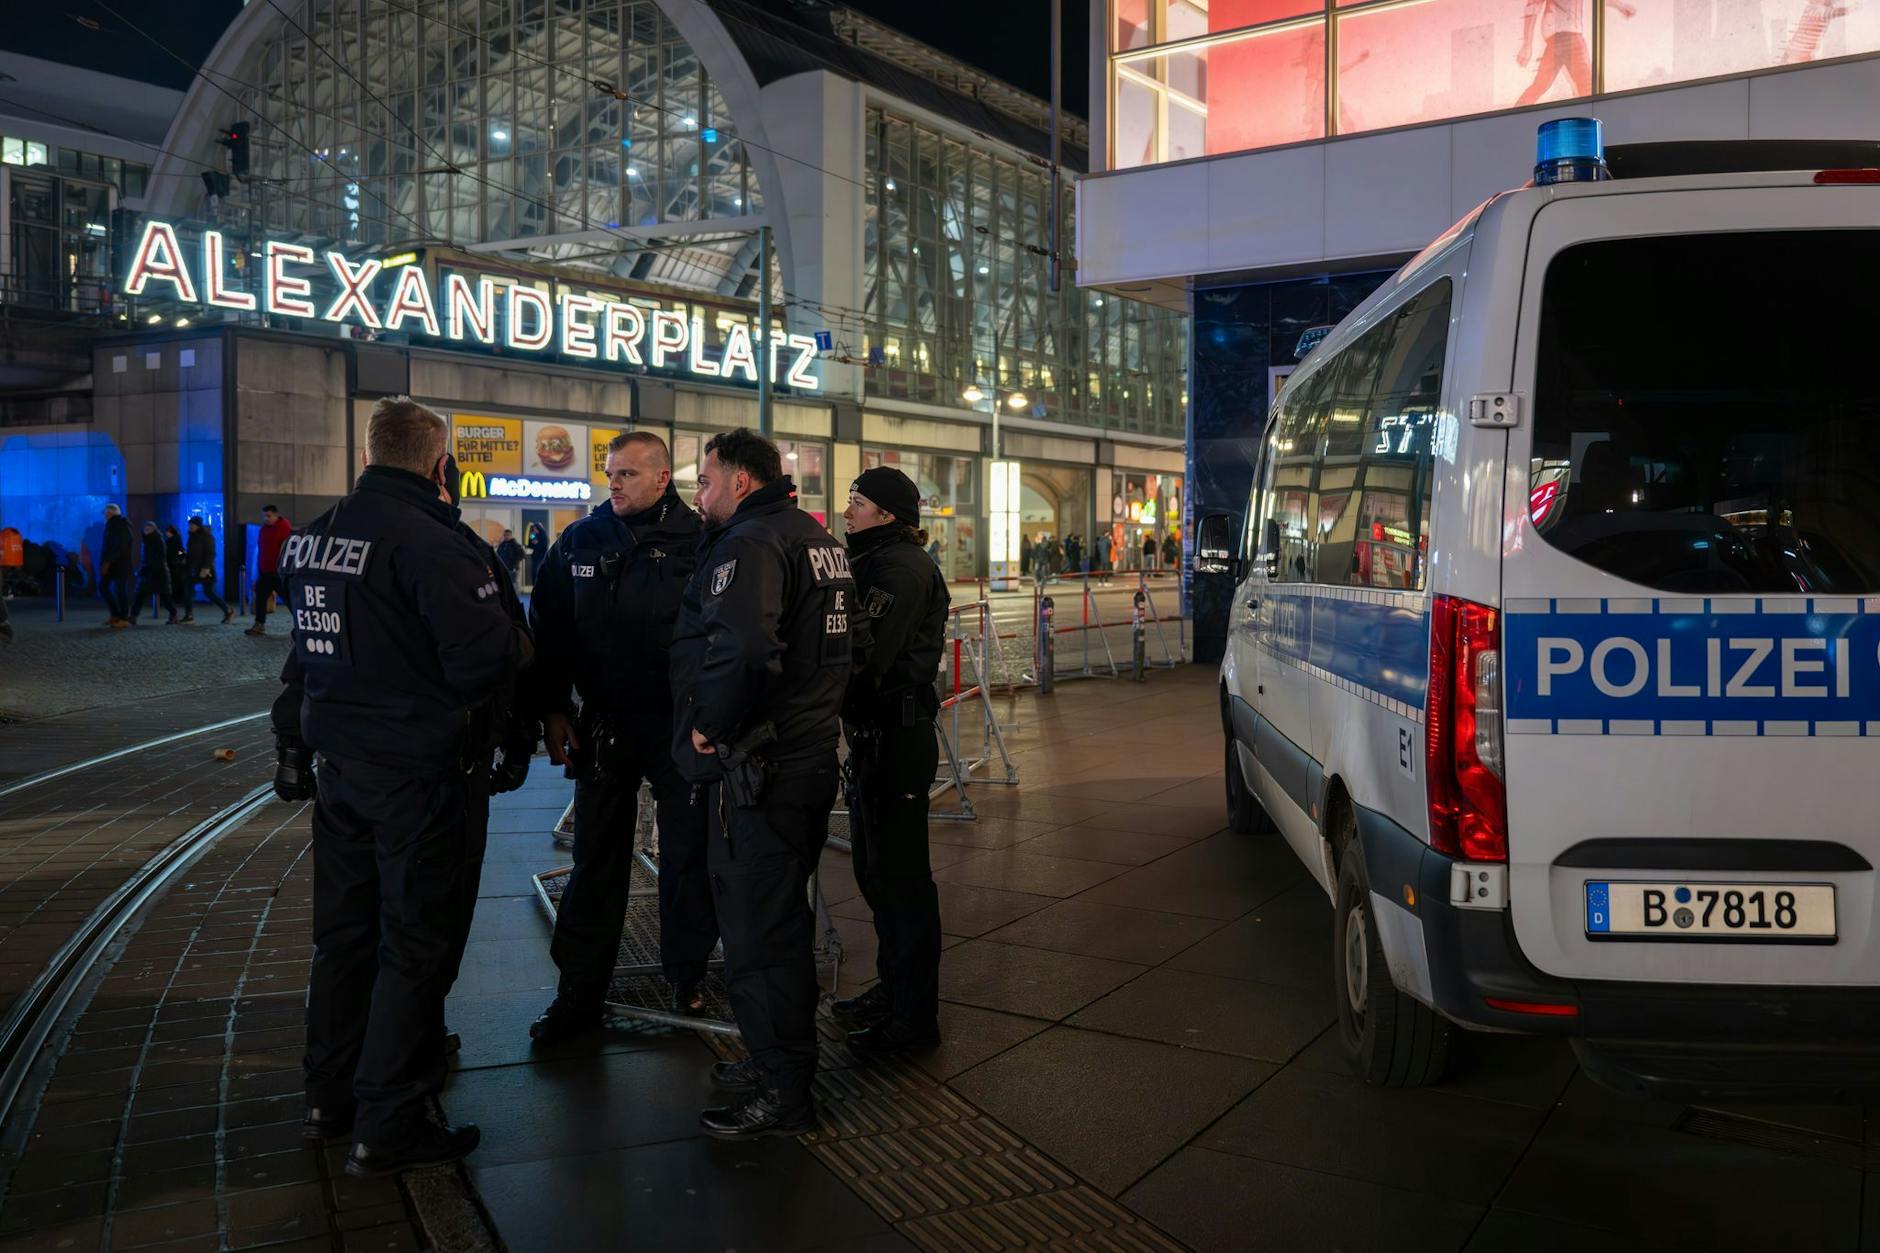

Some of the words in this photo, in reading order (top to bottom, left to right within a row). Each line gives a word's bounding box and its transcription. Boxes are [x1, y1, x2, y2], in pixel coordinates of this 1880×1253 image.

[124, 219, 822, 392] ALEXANDERPLATZ
[457, 426, 505, 439] BURGER
[480, 440, 519, 452] MITTE?
[458, 452, 493, 463] BITTE!
[595, 453, 607, 462] LIE
[489, 478, 591, 499] McDonald's
[282, 534, 372, 576] POLIZEI
[304, 584, 326, 608] BE
[296, 609, 341, 634] E1300
[1537, 636, 1849, 698] POLIZEI
[1593, 912, 1604, 925] D
[1643, 889, 1668, 928] B
[1696, 890, 1798, 929] 7818
